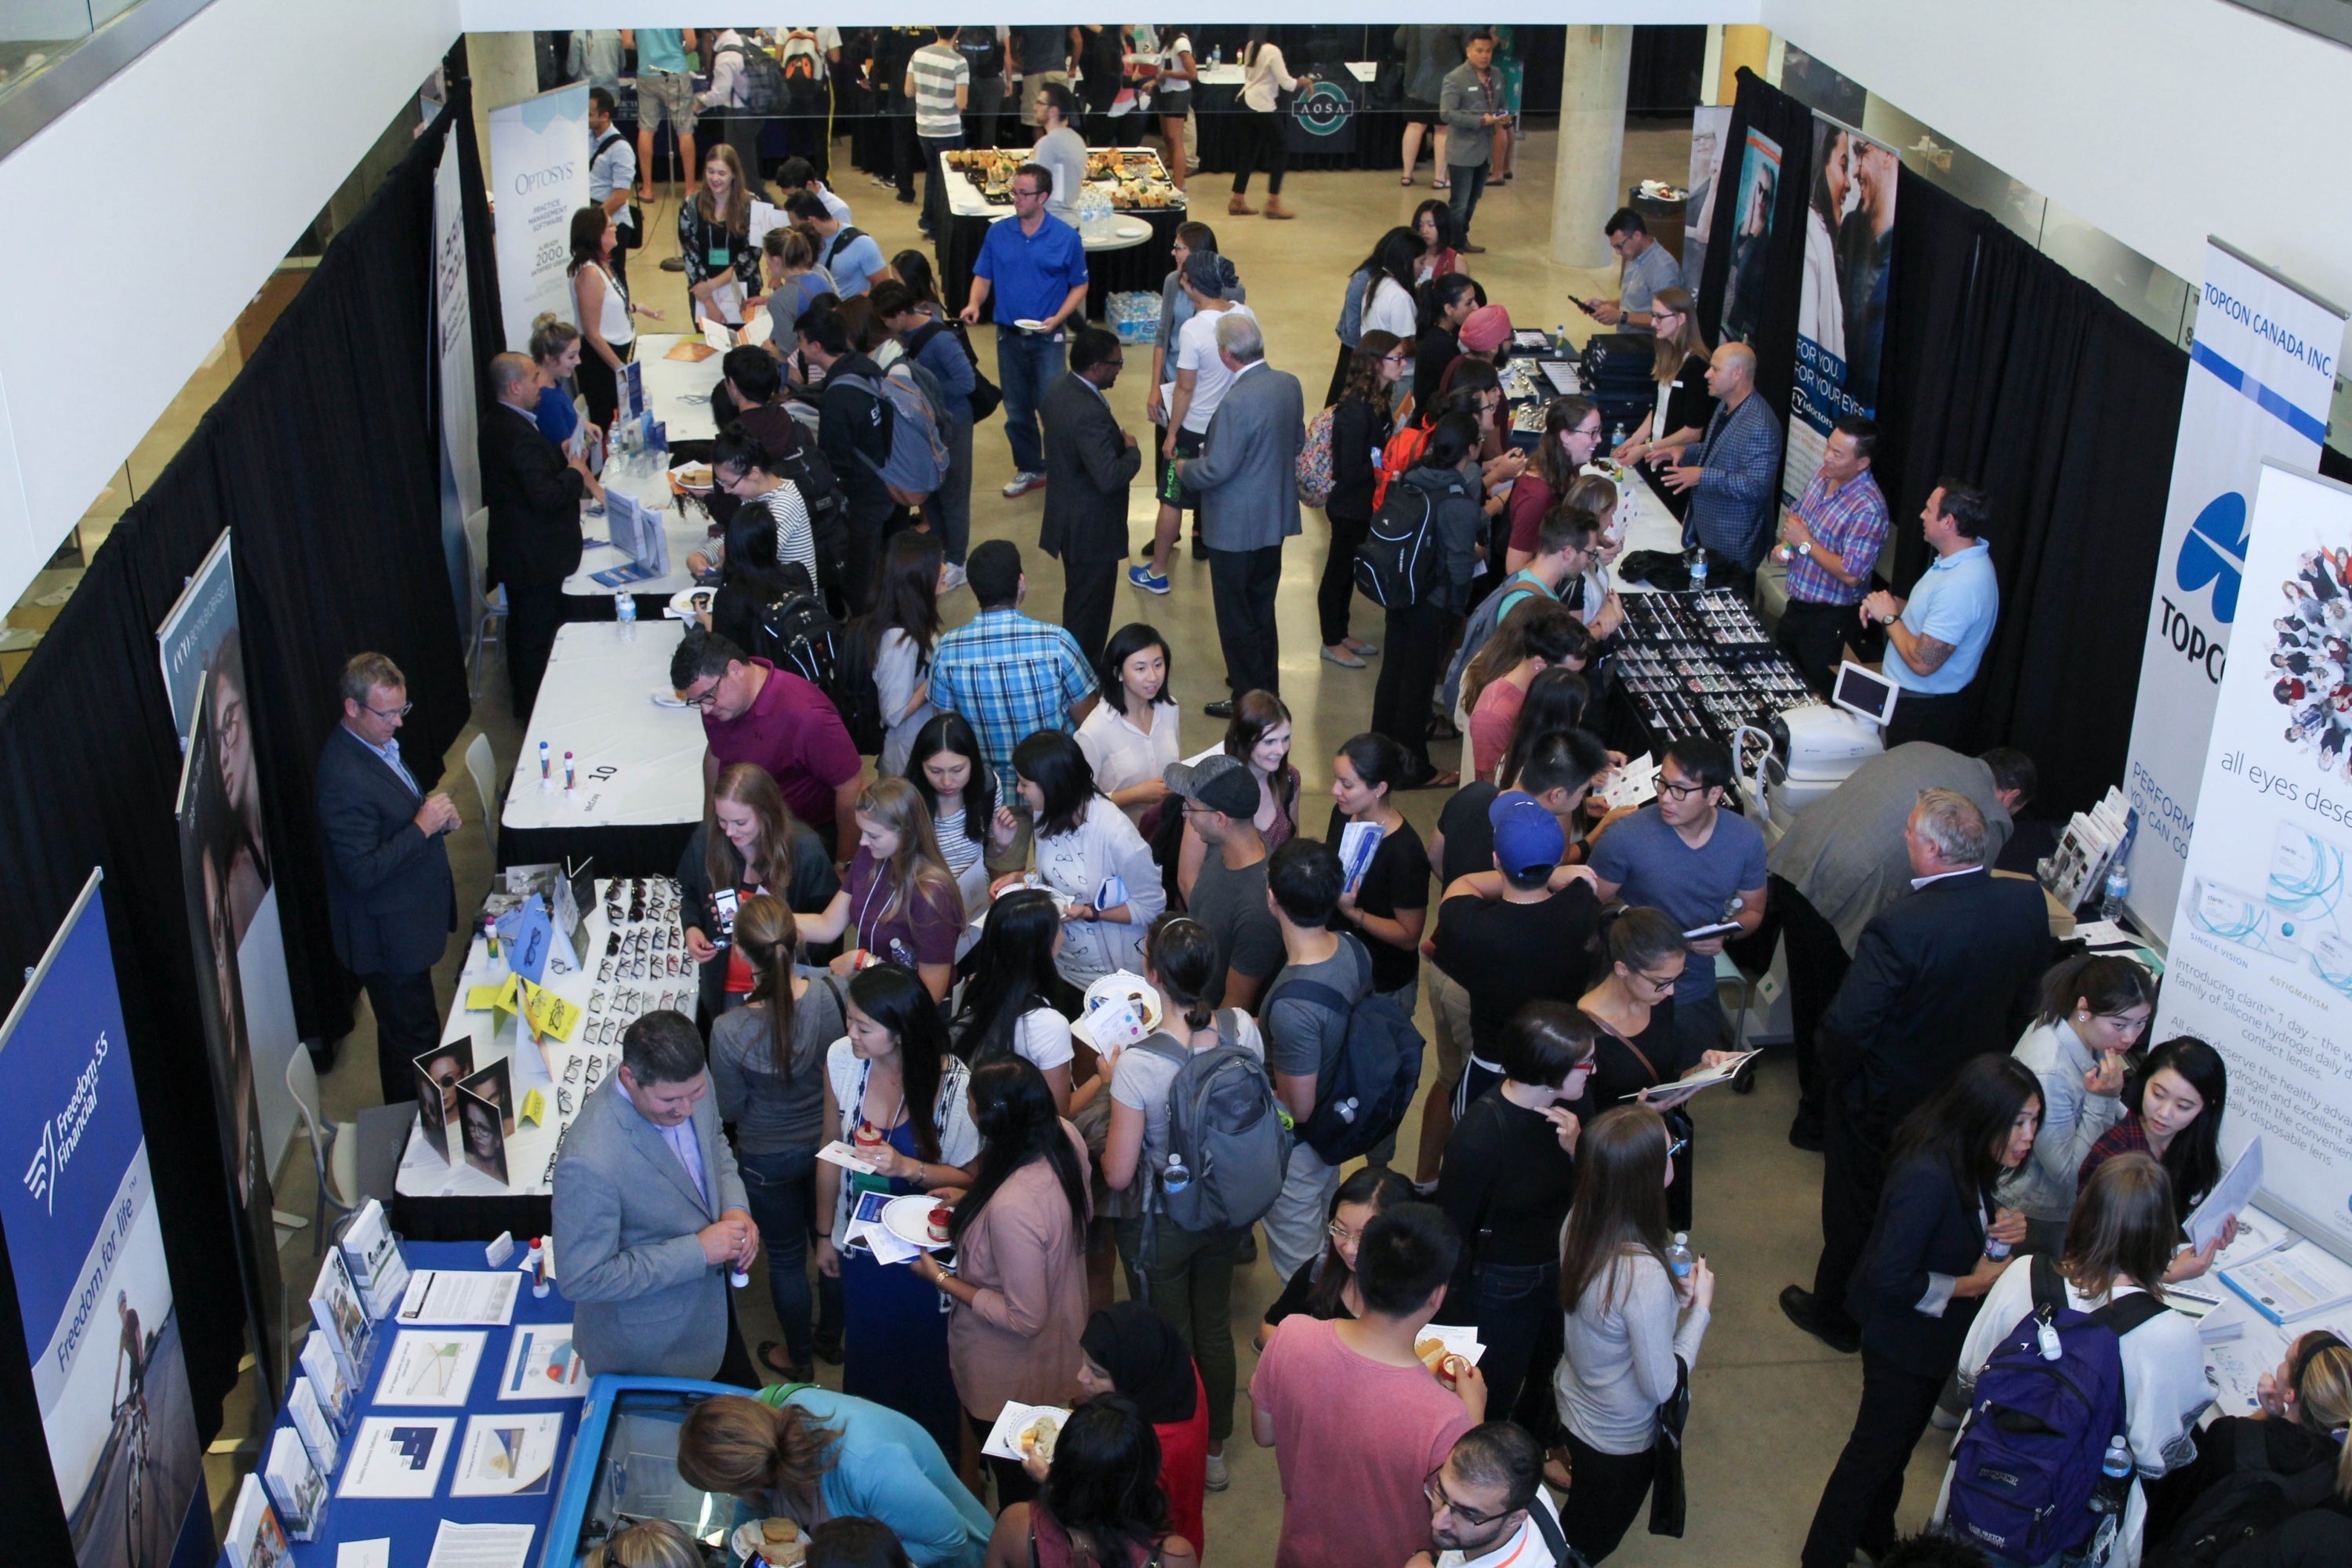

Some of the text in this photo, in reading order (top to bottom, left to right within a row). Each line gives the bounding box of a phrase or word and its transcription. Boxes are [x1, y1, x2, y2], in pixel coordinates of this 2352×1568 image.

[1301, 103, 1345, 114] AOSA
[528, 205, 568, 225] MANAGEMENT
[533, 216, 563, 233] SOFTWARE
[534, 199, 561, 213] PRACTICE
[536, 245, 564, 267] 2000
[2205, 282, 2251, 326] TOPCON
[2253, 314, 2303, 361] CANADA
[2307, 347, 2332, 379] INC.
[1796, 338, 1838, 379] FOR YOU.
[1794, 361, 1814, 387] FOR
[1816, 374, 1841, 405] YOUR
[2161, 596, 2227, 684] TOPC
[588, 766, 618, 782] 10
[2221, 751, 2244, 775] all
[2249, 766, 2298, 801] eyes
[2130, 786, 2147, 817] YOU
[2148, 811, 2170, 842] CAN
[2190, 933, 2249, 969] SINGLE VISION
[2176, 958, 2234, 1000] Introducing
[2288, 1018, 2308, 1039] day
[2321, 1037, 2340, 1055] the
[2269, 975, 2328, 1011] ASTIGMATISM
[2176, 973, 2205, 1000] family
[2209, 993, 2221, 1006] of
[2223, 1001, 2262, 1029] silicone
[2265, 1023, 2313, 1058] hydrogel
[2315, 1049, 2341, 1075] daily
[2170, 1016, 2184, 1031] All
[2214, 1038, 2256, 1072] deserve
[2259, 1066, 2277, 1084] the
[2280, 1075, 2321, 1110] healthy
[2241, 1029, 2322, 1081] contact lenses.
[57, 1030, 108, 1139] Freedom 55
[2233, 1084, 2246, 1098] all
[2248, 1091, 2271, 1114] with
[2274, 1107, 2293, 1126] the
[2270, 1091, 2290, 1108] and
[2293, 1104, 2338, 1138] excellent
[2250, 1110, 2307, 1151] disposable
[2309, 1141, 2334, 1168] lens.
[57, 1268, 103, 1373] Freedom
[102, 1229, 116, 1272] for
